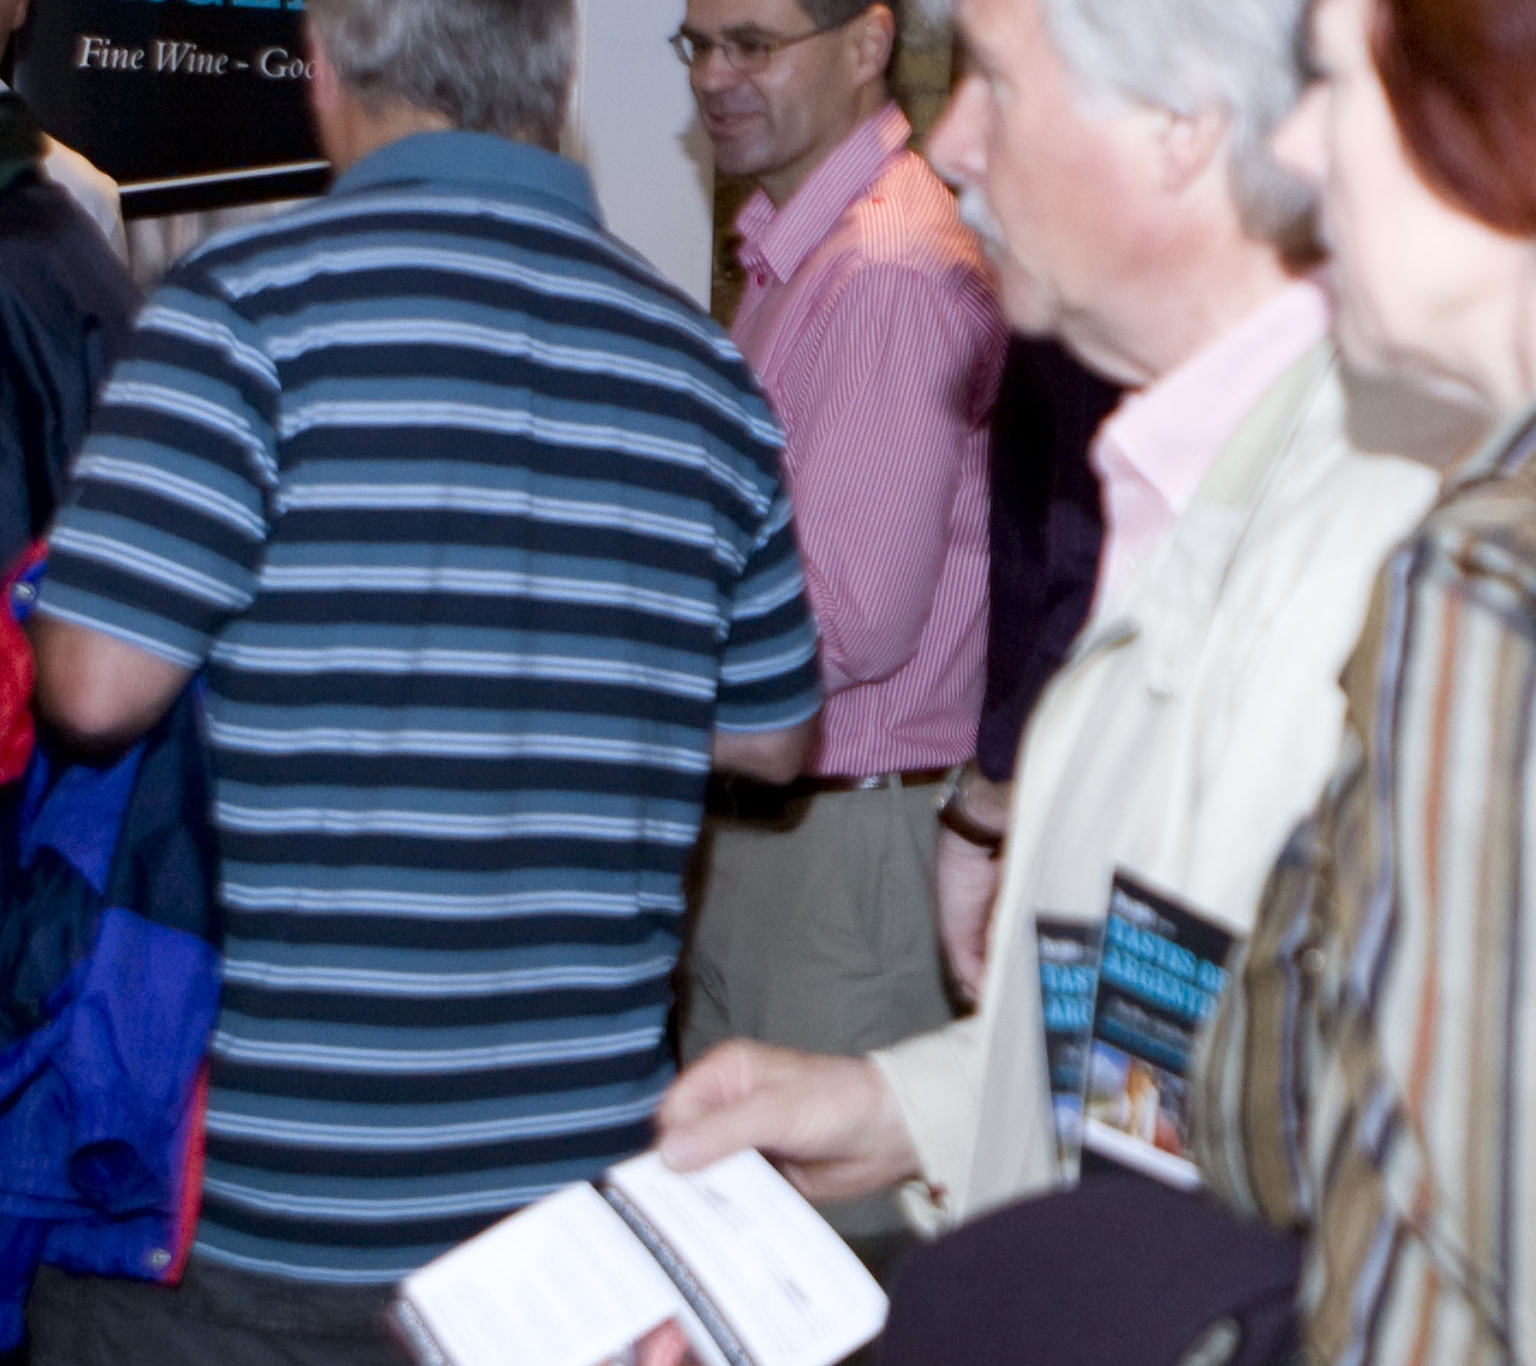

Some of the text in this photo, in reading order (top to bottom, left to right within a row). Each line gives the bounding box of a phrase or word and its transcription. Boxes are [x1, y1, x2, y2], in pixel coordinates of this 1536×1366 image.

[76, 35, 145, 71] Fine
[157, 40, 229, 76] Wine
[259, 47, 316, 81] Goo
